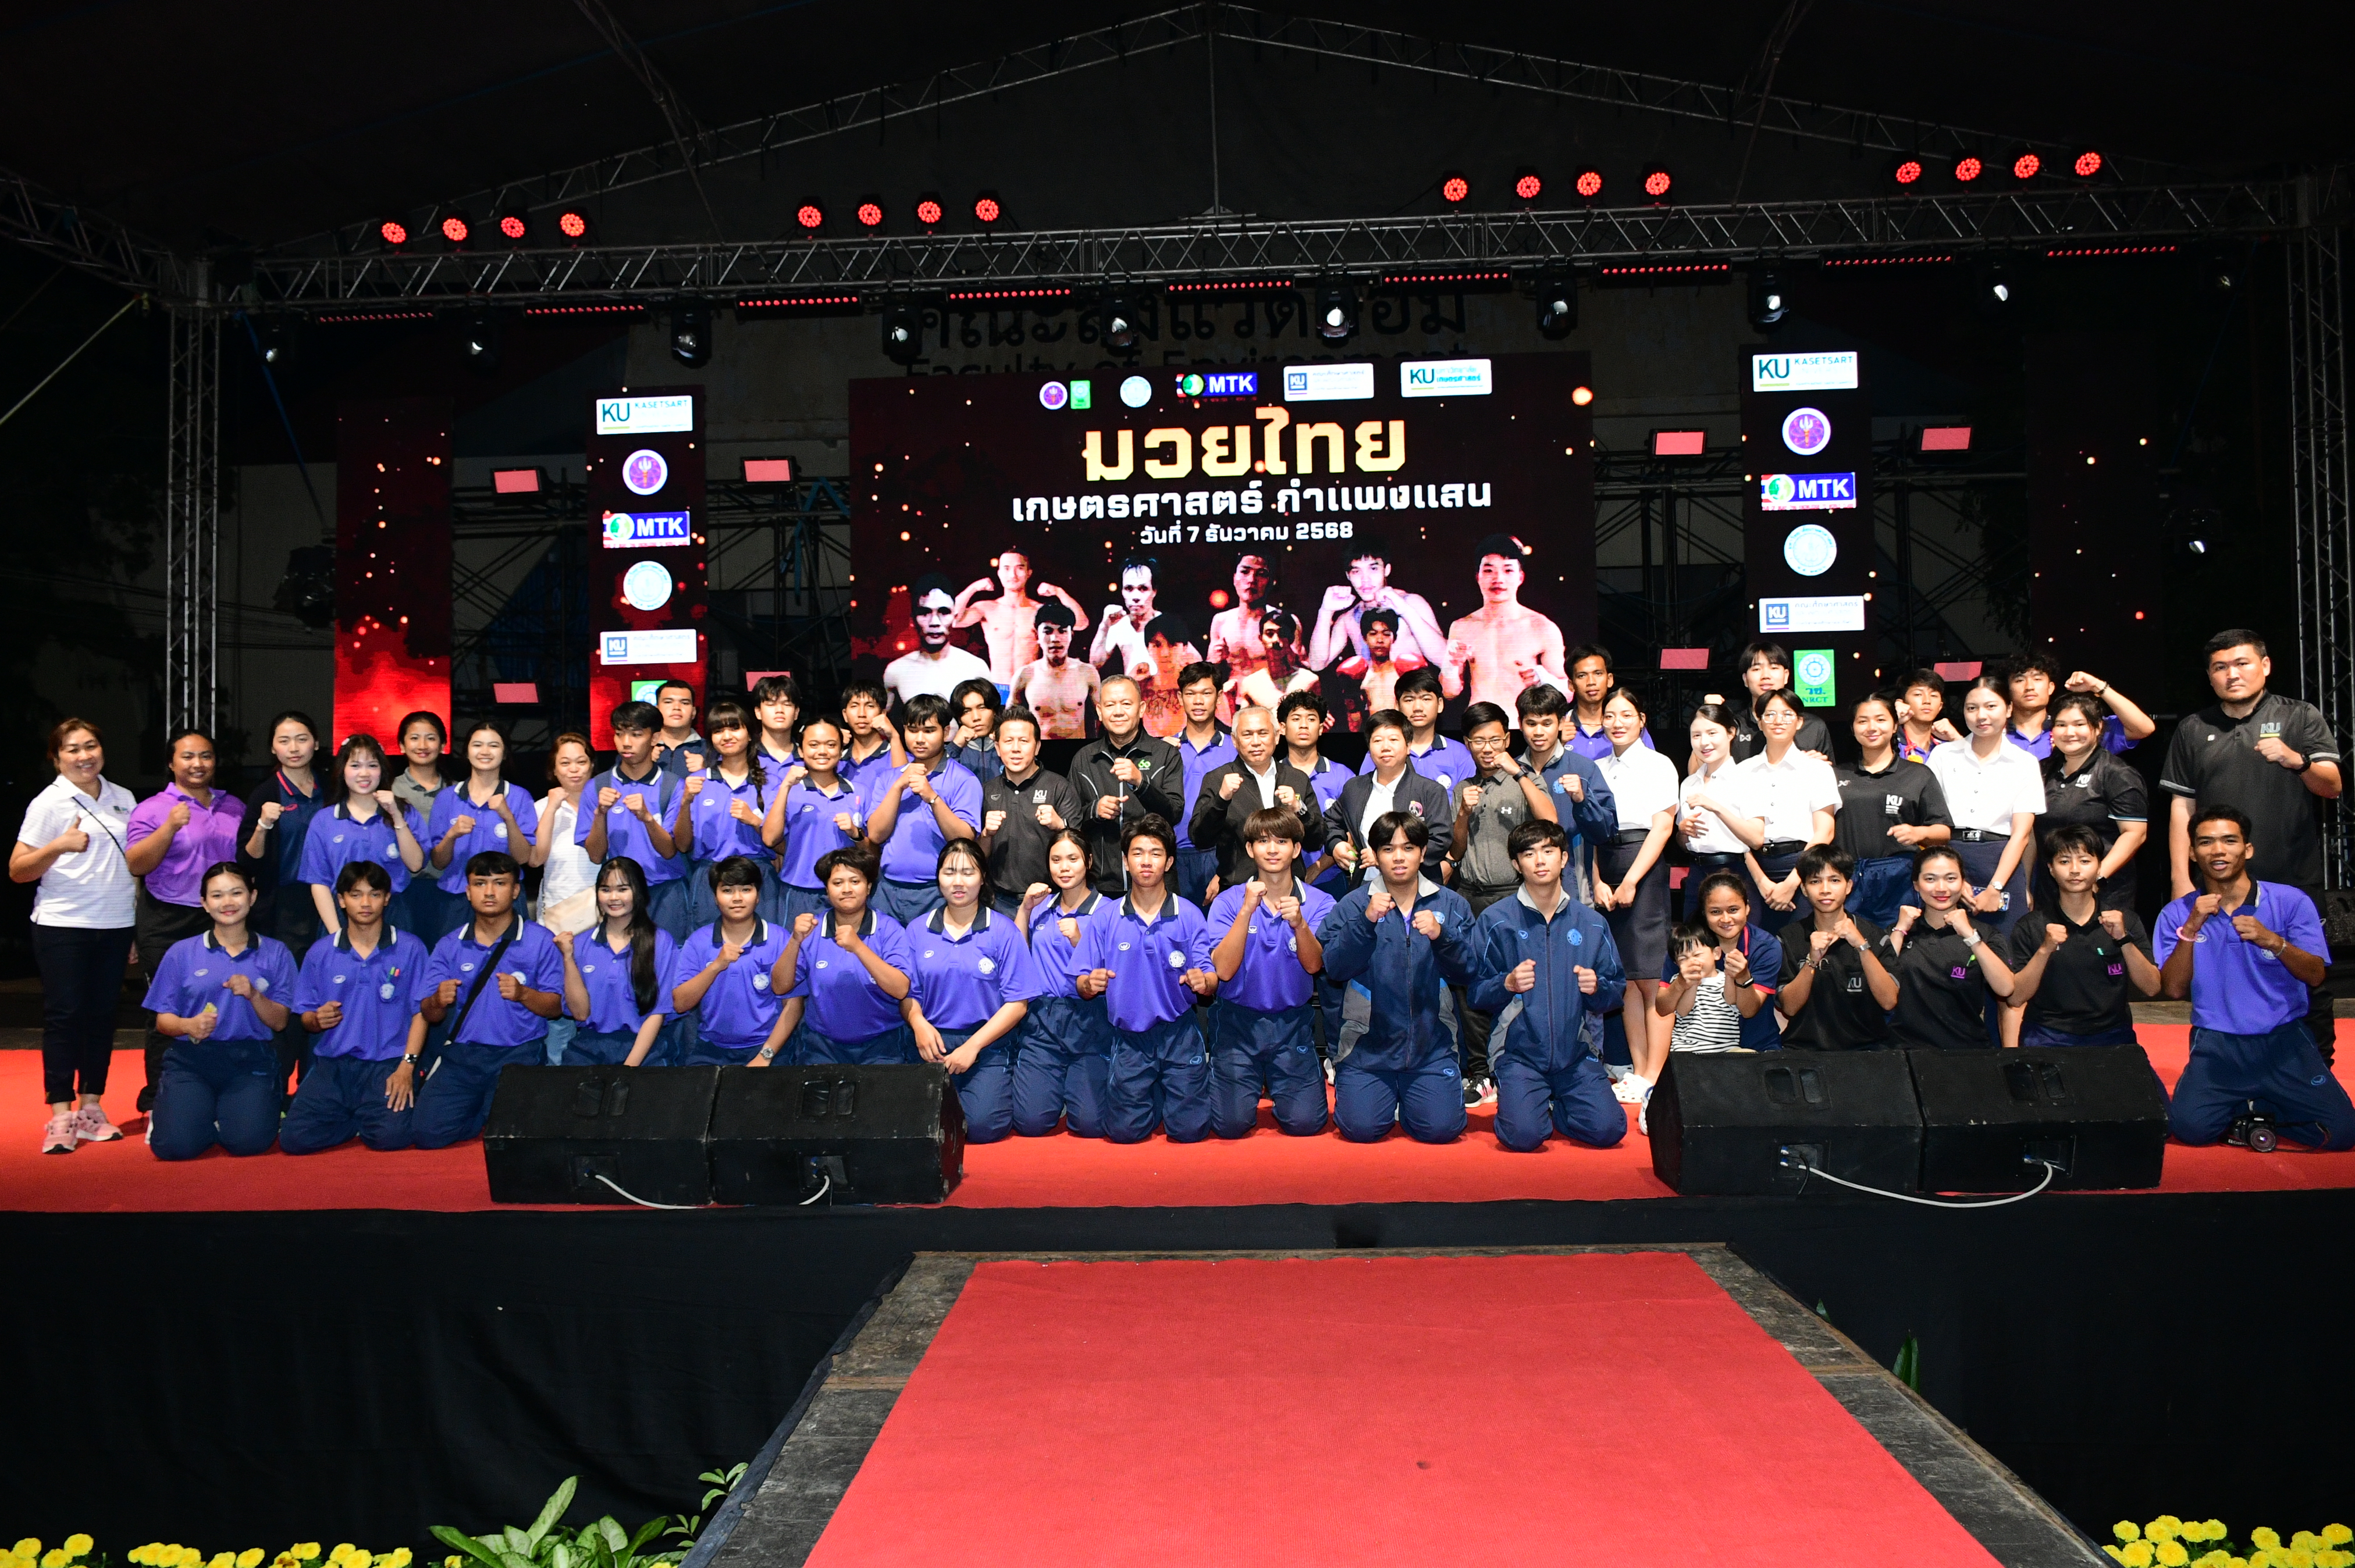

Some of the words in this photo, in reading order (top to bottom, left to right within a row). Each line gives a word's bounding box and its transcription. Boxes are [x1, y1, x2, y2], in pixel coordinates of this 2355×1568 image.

[1795, 356, 1853, 365] KASETSART
[1759, 358, 1790, 379] KU
[1290, 375, 1305, 385] KU
[1410, 368, 1435, 384] KU
[1208, 375, 1254, 393] MTK
[635, 400, 687, 408] KASETSART
[602, 402, 630, 422] KU
[1086, 404, 1406, 482] มวยไทย
[1798, 479, 1850, 499] MTK
[1013, 480, 1262, 521] เกษตรศาสตร์
[1277, 478, 1490, 512] กำแพงแสน
[637, 518, 685, 537] MTK
[1140, 520, 1182, 544] วันที่
[1187, 526, 1200, 543] 7
[1205, 523, 1289, 542] ธันวาคม
[1296, 522, 1353, 539] 2568
[1768, 606, 1786, 618] KU
[609, 639, 625, 651] KU
[2260, 722, 2280, 733] KU
[2077, 774, 2091, 783] KU
[1034, 789, 1047, 797] KU
[1886, 794, 1903, 806] KU
[1952, 966, 1965, 976] KU
[2108, 963, 2122, 973] KU
[1848, 977, 1862, 988] KU
